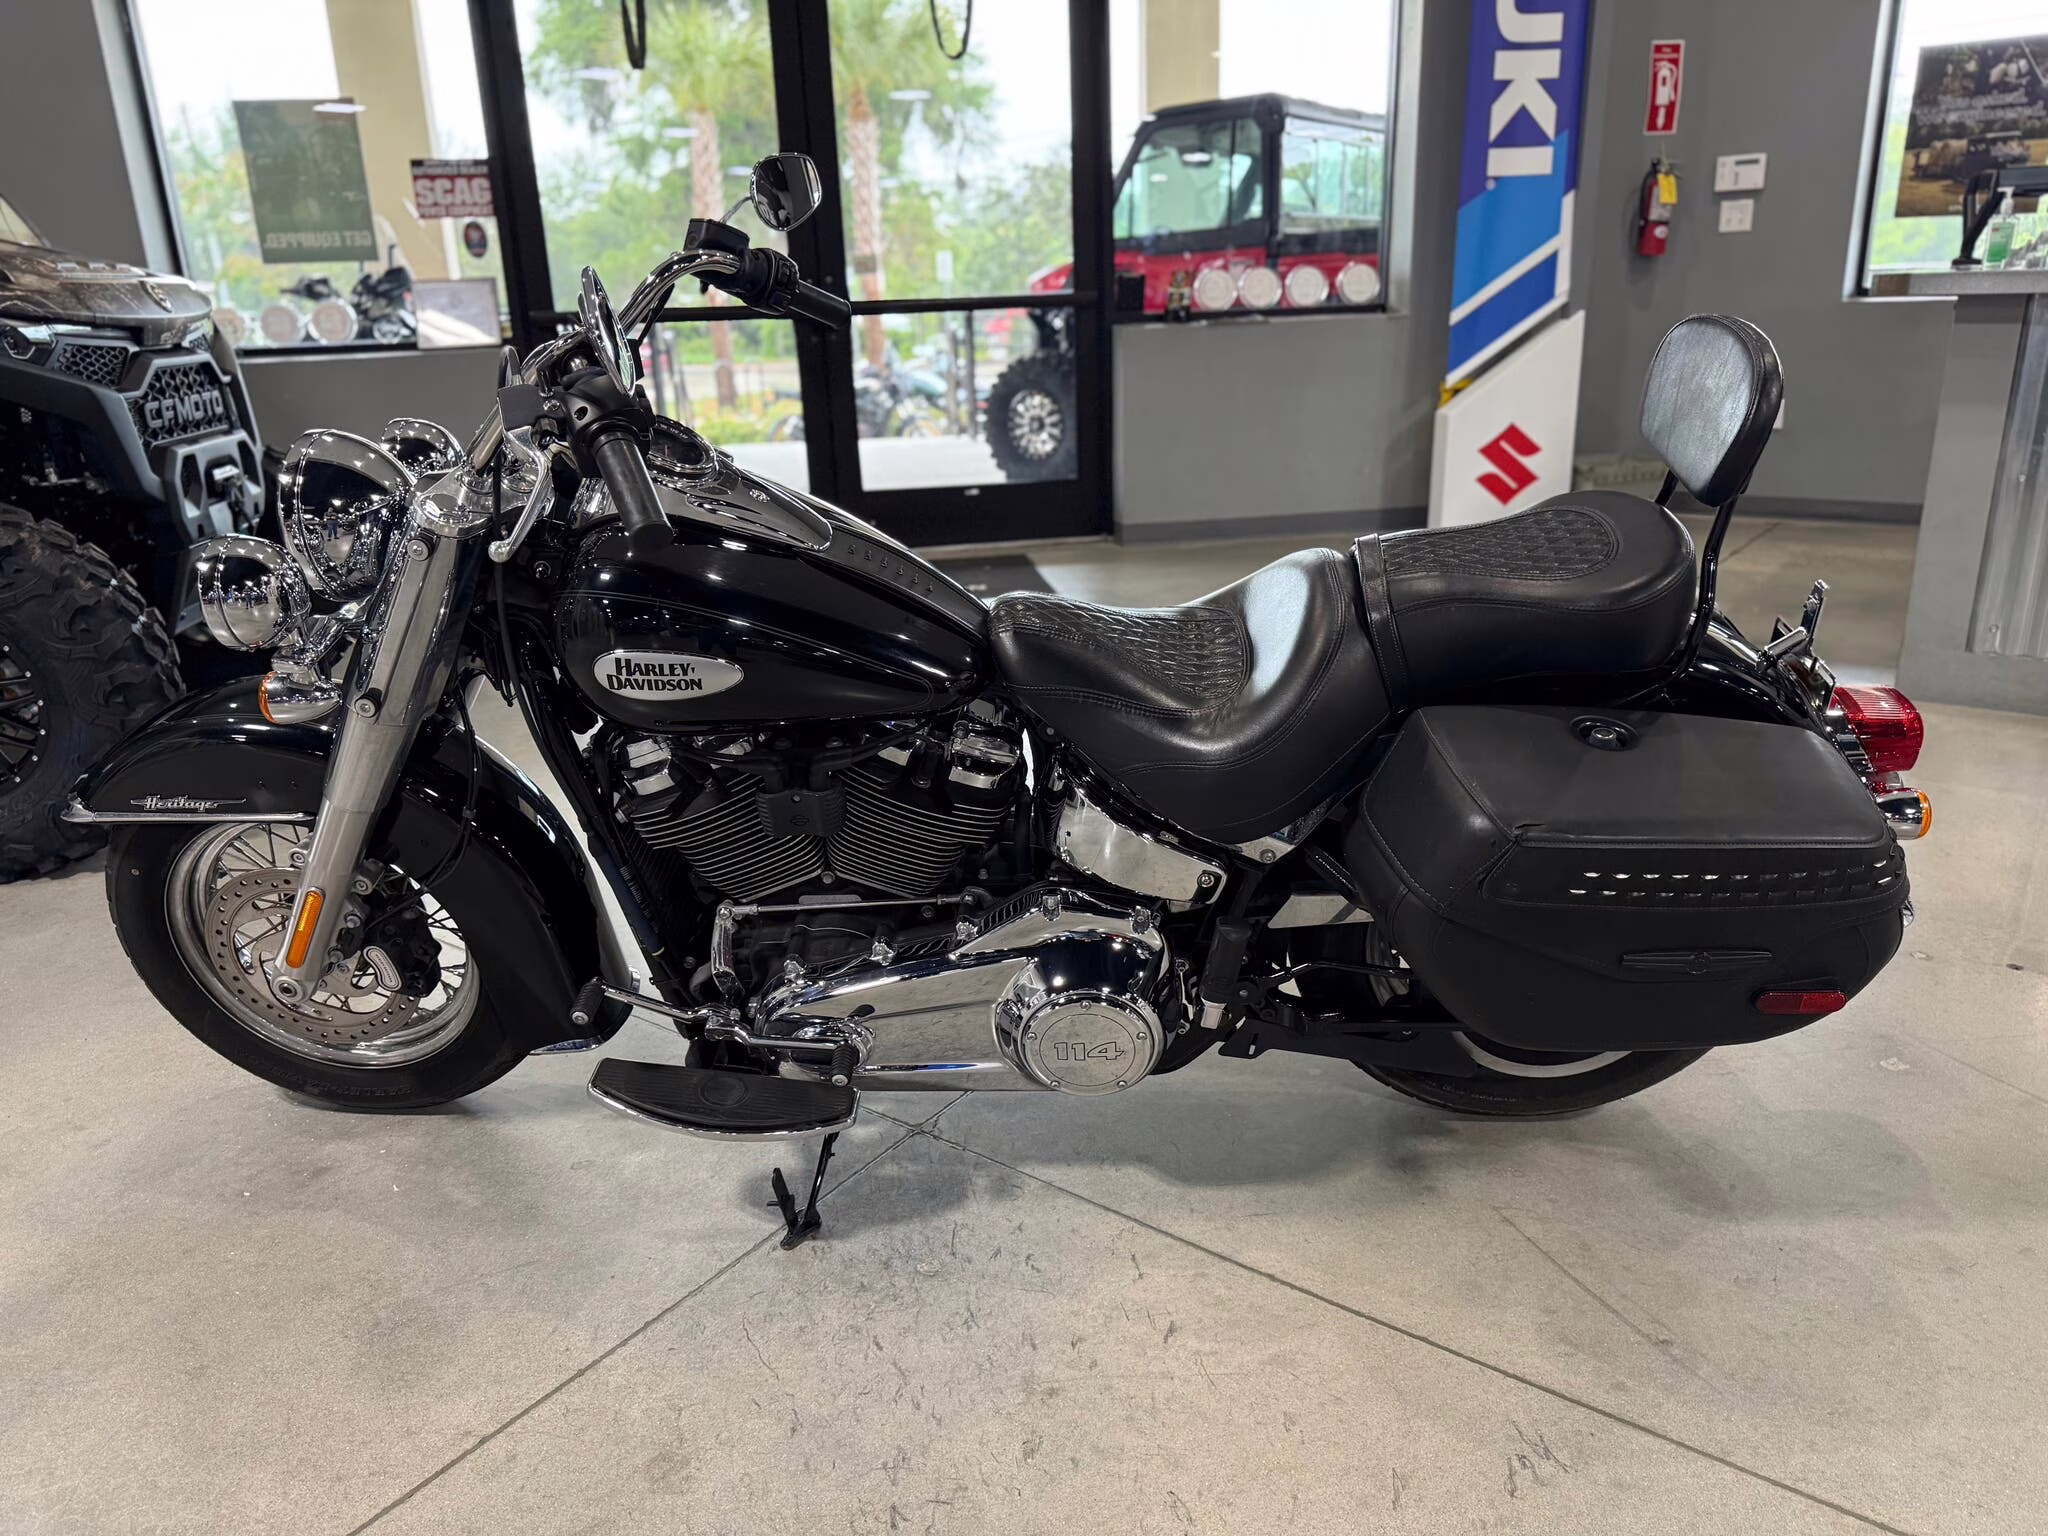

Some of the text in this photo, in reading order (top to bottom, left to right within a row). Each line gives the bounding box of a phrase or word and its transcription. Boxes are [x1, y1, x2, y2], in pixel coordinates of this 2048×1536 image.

[415, 177, 493, 206] SCAG
[144, 389, 225, 429] CFMOTO
[606, 674, 703, 691] DAVIDSON
[144, 795, 219, 812] Heritage
[1054, 1041, 1125, 1061] 114
